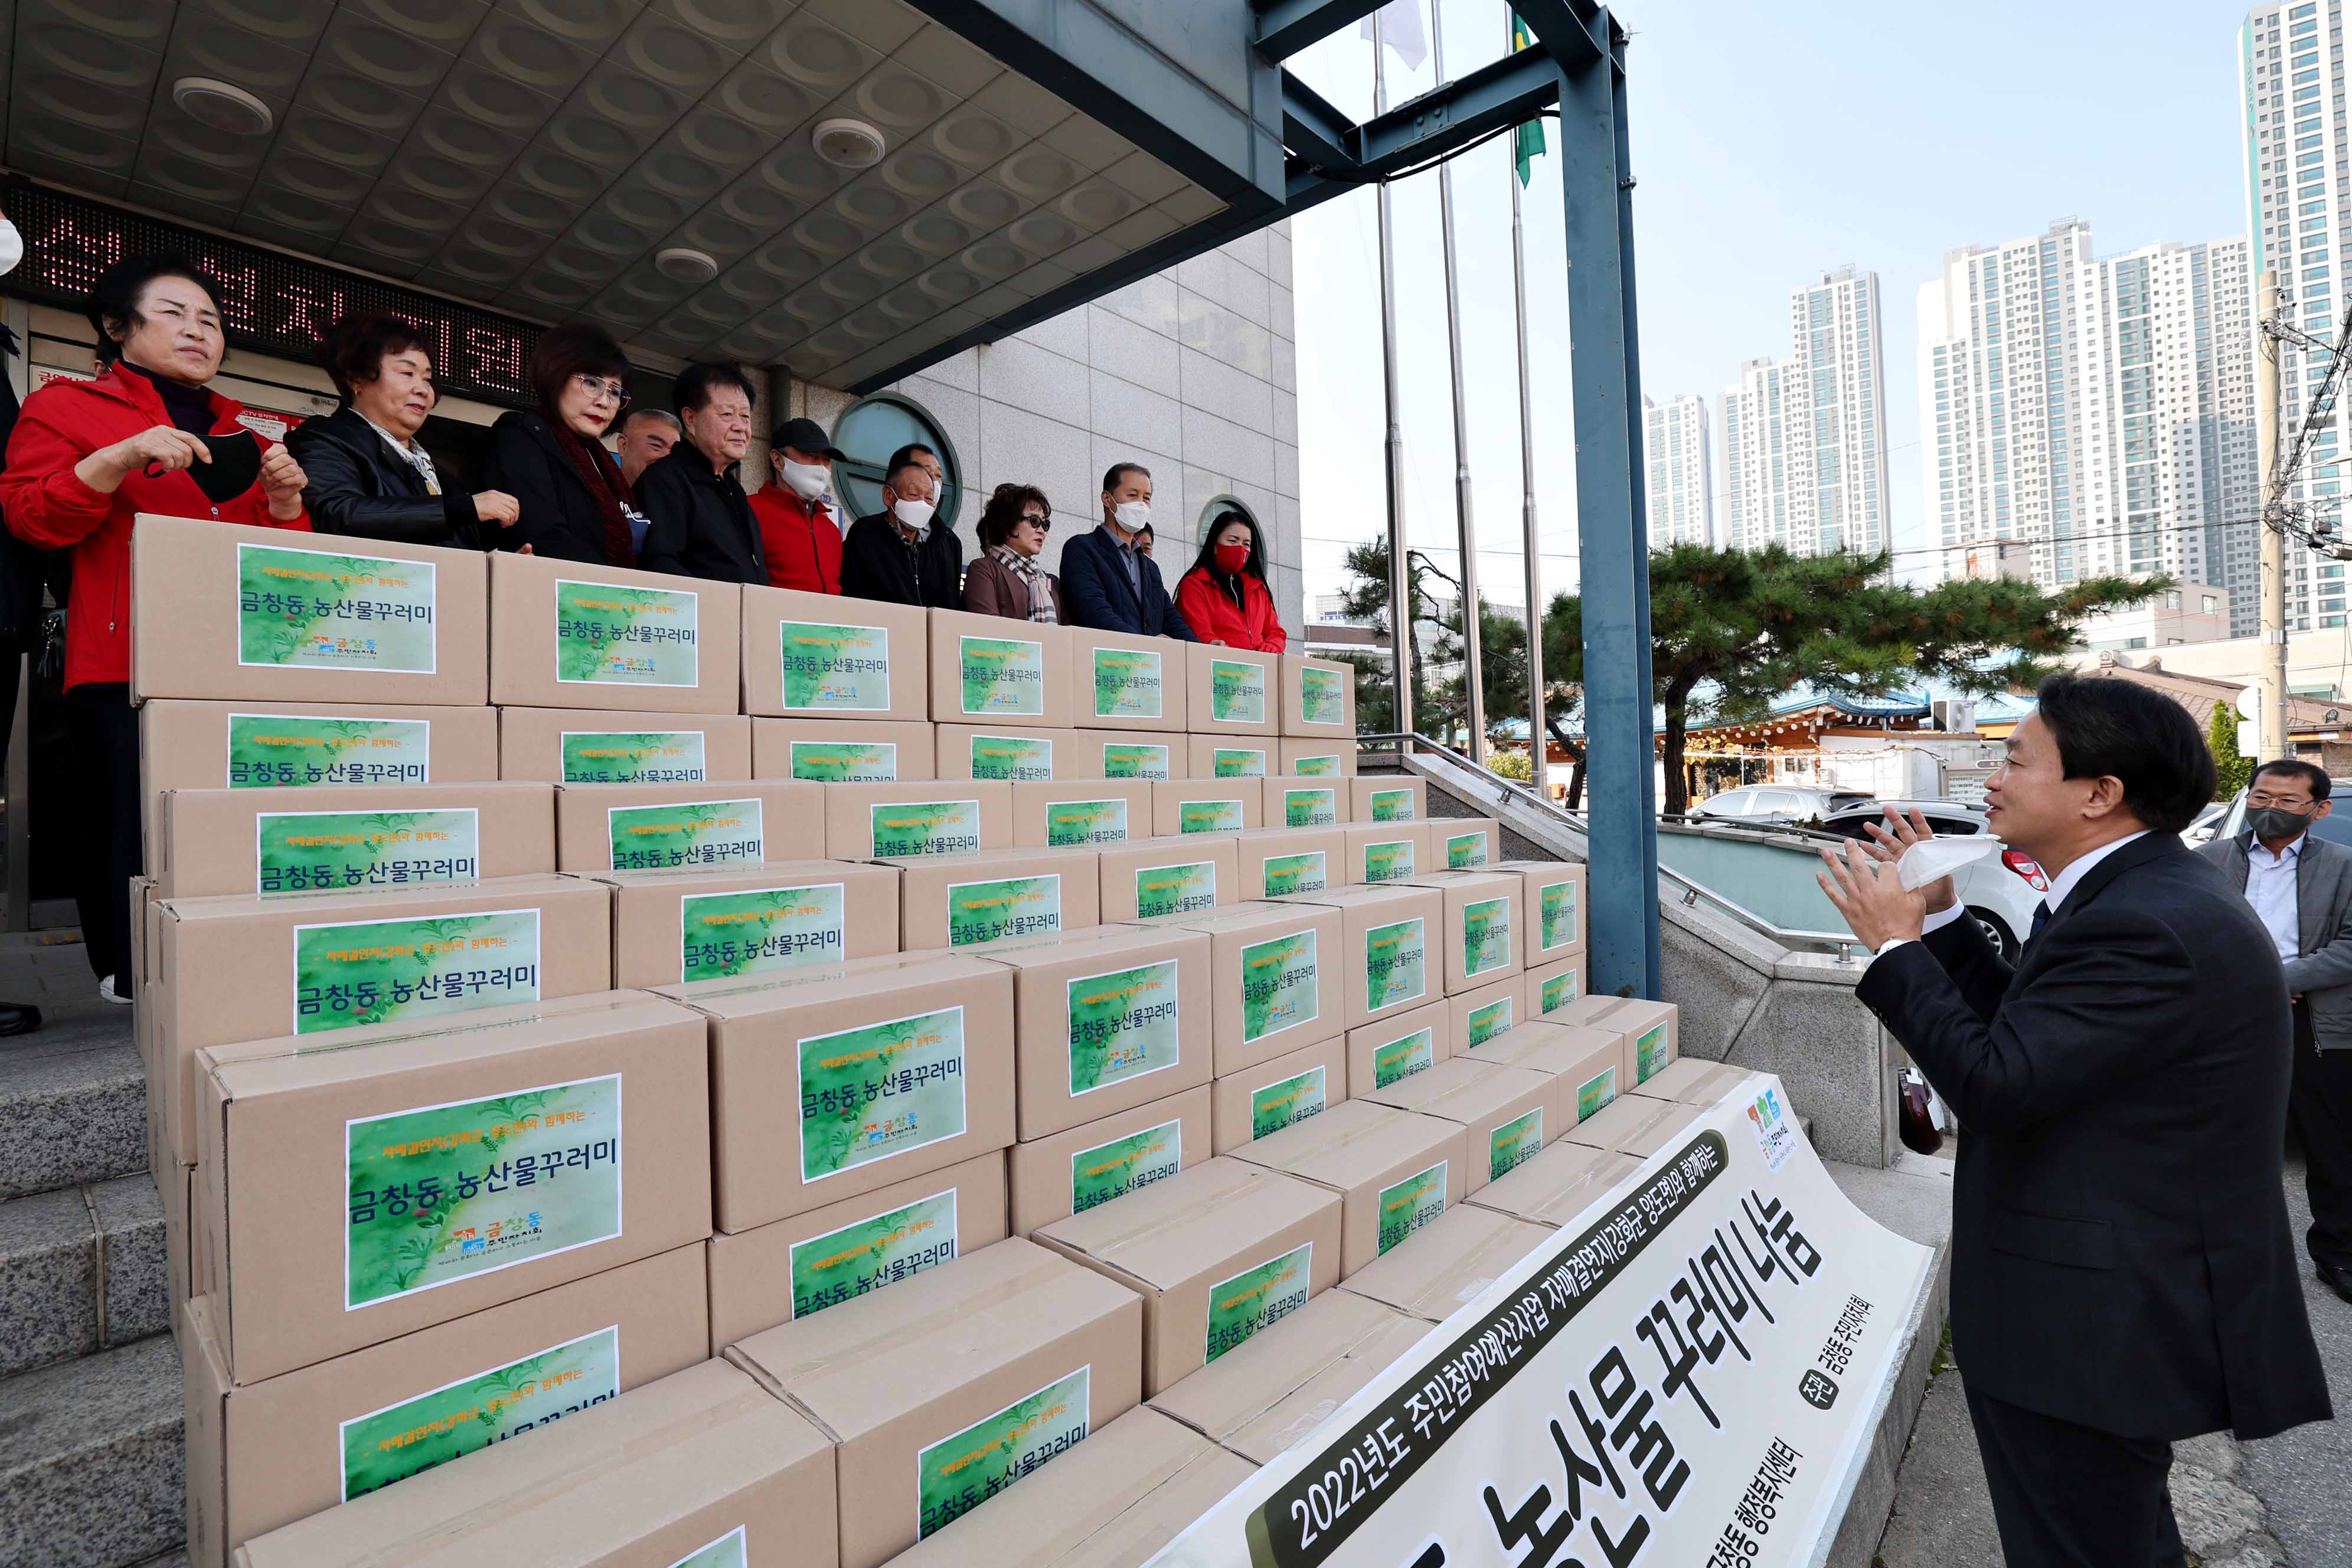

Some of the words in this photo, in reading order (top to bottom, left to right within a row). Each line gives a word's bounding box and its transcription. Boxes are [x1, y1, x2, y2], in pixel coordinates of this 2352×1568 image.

[240, 591, 305, 616] 금창동
[313, 597, 432, 625] 농산물꾸러미
[558, 619, 604, 640] 금창동
[609, 623, 695, 646] 농산물꾸러미
[782, 655, 818, 672] 금창동
[821, 657, 886, 674] 농산물꾸러미
[962, 666, 988, 681] 금창동
[991, 668, 1041, 683] 농산물꾸러미
[1095, 674, 1116, 687] 금창동
[1119, 675, 1159, 689] 농산물꾸러미
[230, 762, 296, 782] 금창동
[304, 763, 424, 783] 농산물꾸러미
[972, 765, 998, 779] 금창동
[1001, 766, 1050, 780] 농산물꾸러미
[873, 839, 908, 858] 금창동
[912, 835, 978, 855] 농산물꾸러미
[1077, 829, 1125, 846] 농산물꾸러미
[612, 849, 663, 870] 금창동
[668, 839, 761, 867] 농산물꾸러미
[260, 864, 334, 891] 금창동
[343, 857, 474, 886] 농산물꾸러미
[1138, 901, 1164, 920] 금창동
[1166, 893, 1214, 915] 농산물꾸러미
[950, 922, 986, 945] 금창동
[991, 912, 1059, 939] 농산물꾸러미
[684, 940, 737, 968] 금창동
[744, 929, 841, 961] 농산물꾸러미
[298, 981, 380, 1016] 금창동
[390, 964, 535, 1005] 농산물꾸러미
[1243, 978, 1268, 1002] 금창동
[1270, 963, 1315, 993] 농산물꾸러미
[1070, 1017, 1106, 1046] 금창동
[1110, 1000, 1175, 1035] 농산물꾸러미
[802, 1082, 857, 1120] 금창동
[863, 1056, 961, 1103] 농산물꾸러미
[882, 1111, 918, 1133] 금창동
[349, 1175, 443, 1226] 금창동
[455, 1138, 616, 1202] 농산물꾸러미
[485, 1210, 543, 1240] 금창동
[486, 1226, 542, 1247] 주민자치회
[1377, 1220, 1401, 1250] 금창동
[1403, 1198, 1444, 1236] 농산물꾸러미
[793, 1279, 849, 1319] 금창동
[855, 1238, 954, 1296] 농산물꾸러미
[1834, 1293, 1875, 1344] 주민자치회
[1206, 1319, 1242, 1357] 금창동
[1291, 1416, 1411, 1550] 2022년도
[1403, 1292, 1550, 1440] 주민참여예산사업
[1540, 1206, 1647, 1310] 자매결연지(강화군
[1639, 1168, 1687, 1225] 양도면)와
[1680, 1144, 1719, 1188] 함께하는
[1818, 1336, 1853, 1376] 금창동
[542, 1365, 583, 1393] 함께하는
[1802, 1373, 1834, 1404] 주관
[1734, 1436, 1804, 1535] 행정복지센터
[920, 1482, 978, 1541] 금창동
